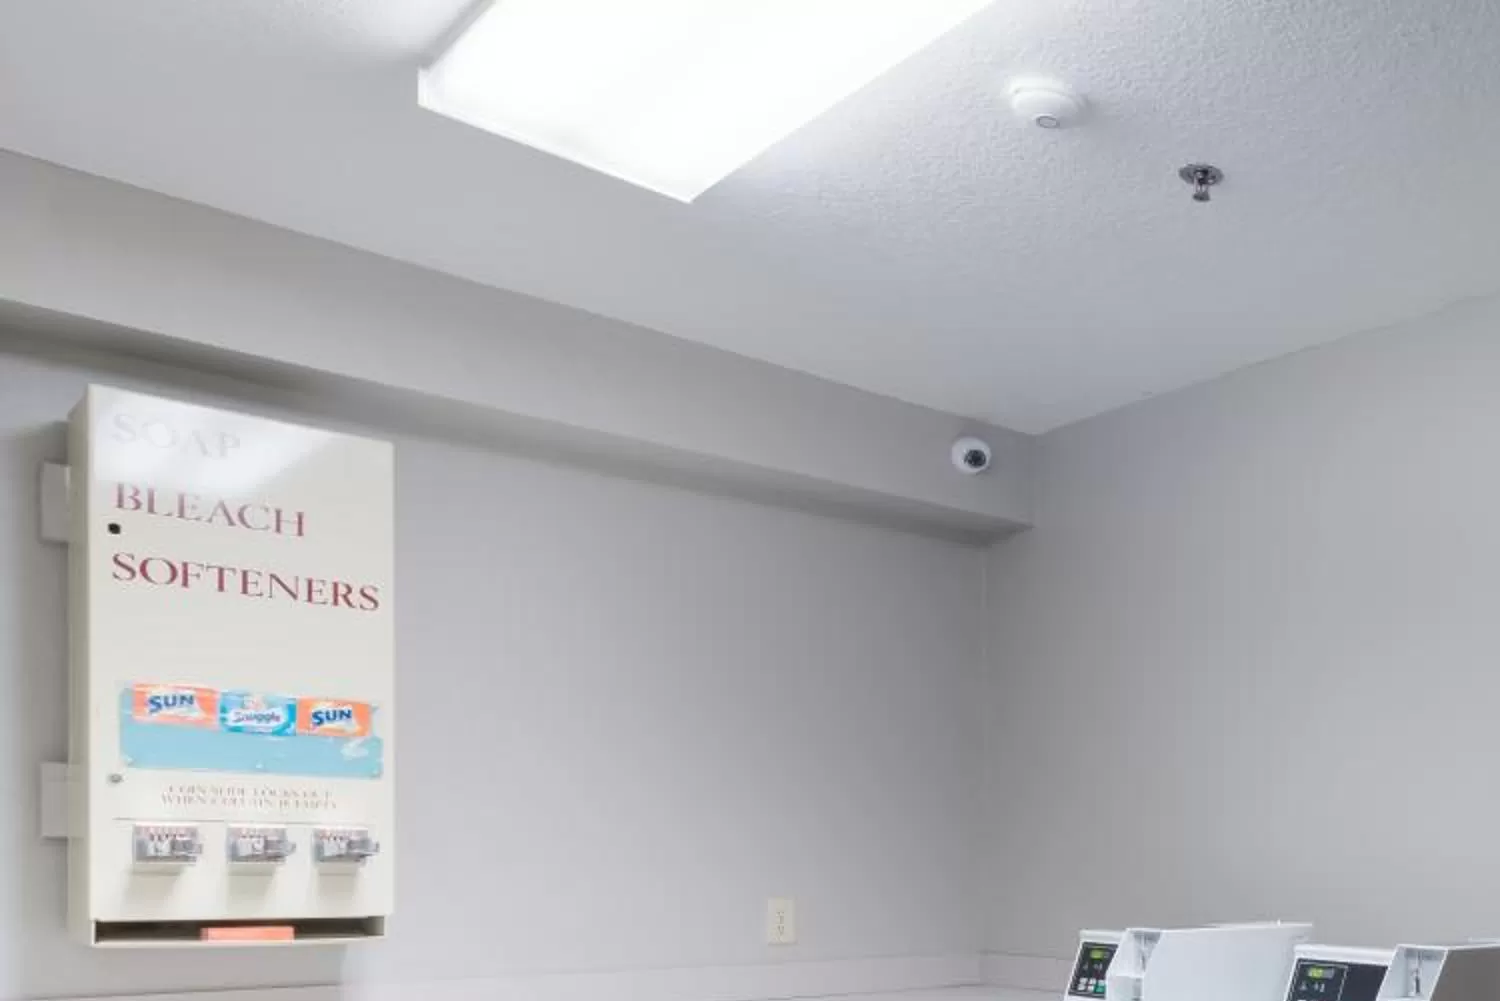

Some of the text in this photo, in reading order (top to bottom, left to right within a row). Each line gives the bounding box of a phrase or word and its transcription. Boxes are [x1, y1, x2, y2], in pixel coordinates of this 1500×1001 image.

[112, 412, 241, 459] SOAP
[116, 482, 304, 537] BLEACH
[112, 551, 380, 611] SOFTENERS
[148, 695, 195, 713] SUN
[311, 709, 352, 726] SUN
